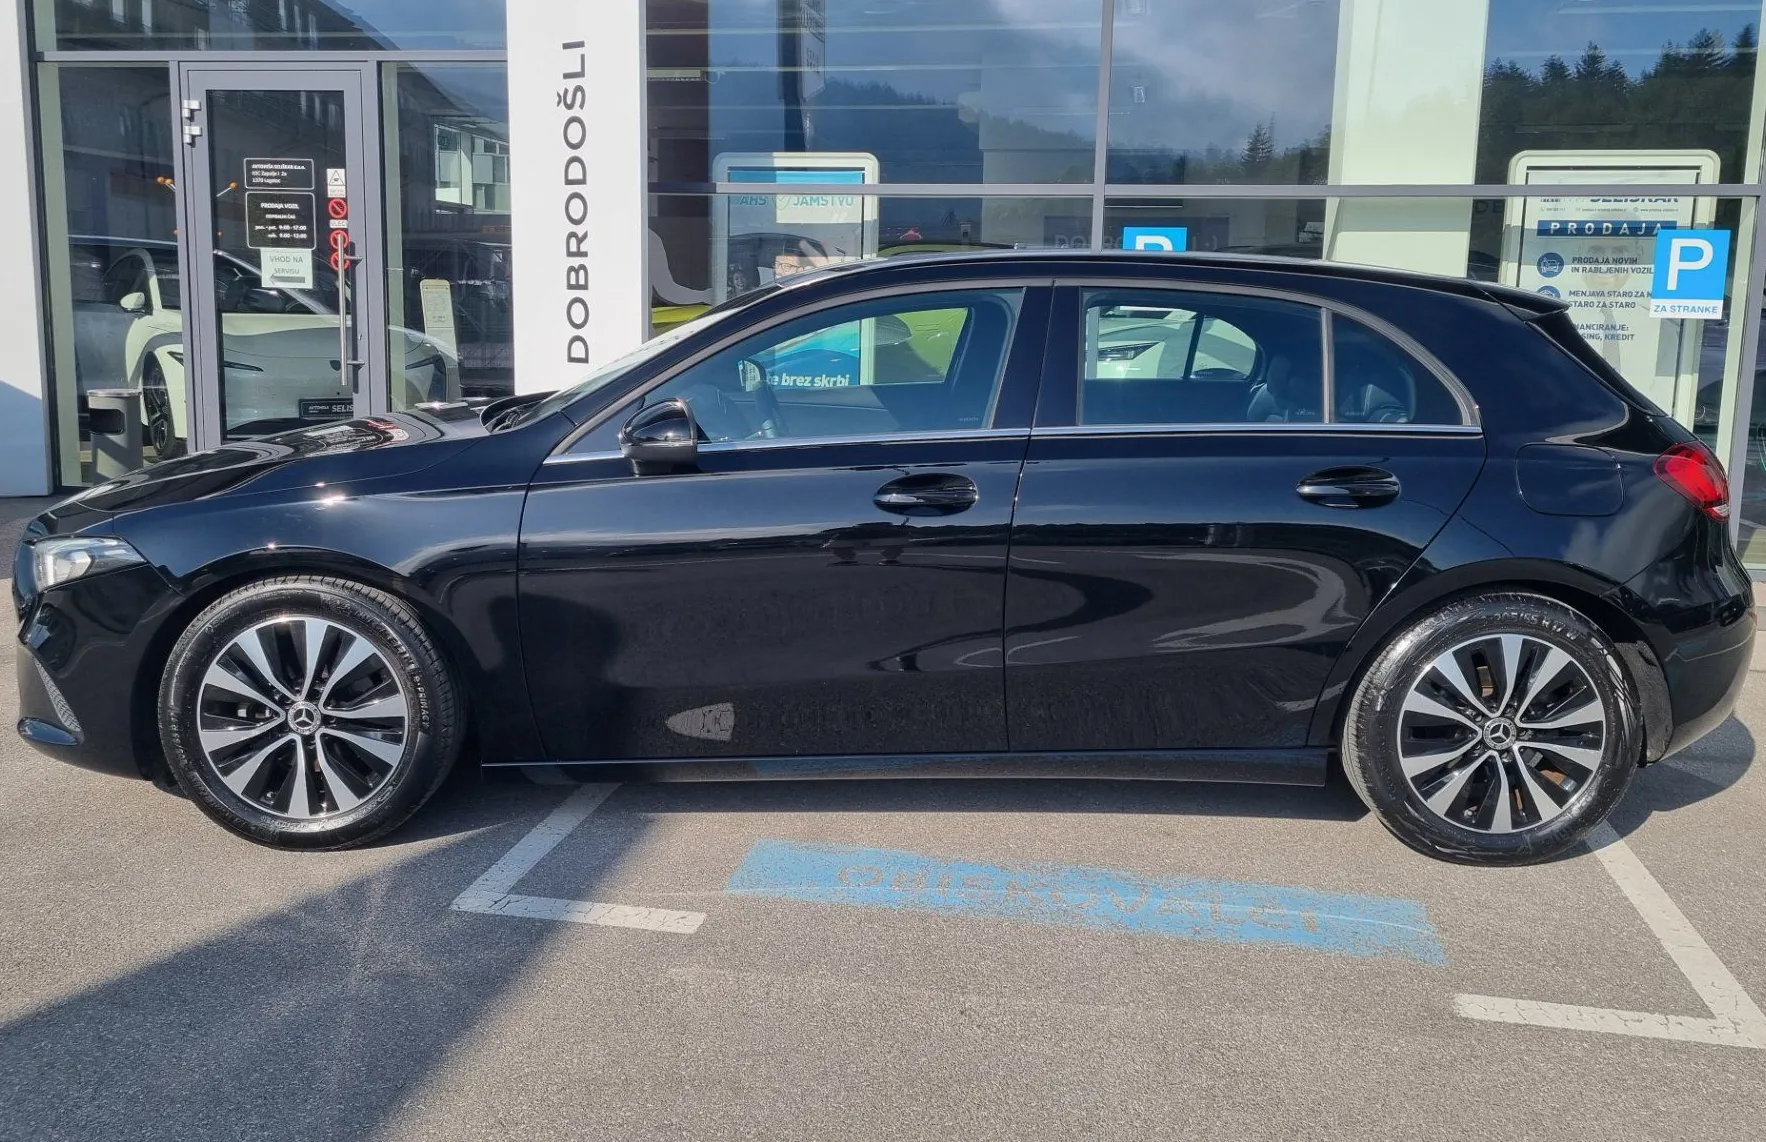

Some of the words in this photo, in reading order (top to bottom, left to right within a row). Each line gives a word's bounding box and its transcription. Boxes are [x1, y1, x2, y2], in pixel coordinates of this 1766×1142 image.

[556, 40, 590, 363] DOBRODOŠLI
[1550, 222, 1662, 235] PRODAJA
[269, 255, 291, 263] VHOD
[293, 255, 303, 263] NA
[1612, 257, 1638, 265] NOVIH
[1666, 238, 1714, 291] P
[1581, 266, 1629, 274] RABLJENIH
[1653, 305, 1668, 313] ZA
[1670, 305, 1719, 314] STRANKE
[781, 373, 812, 387] brez
[814, 375, 850, 387] skrbi
